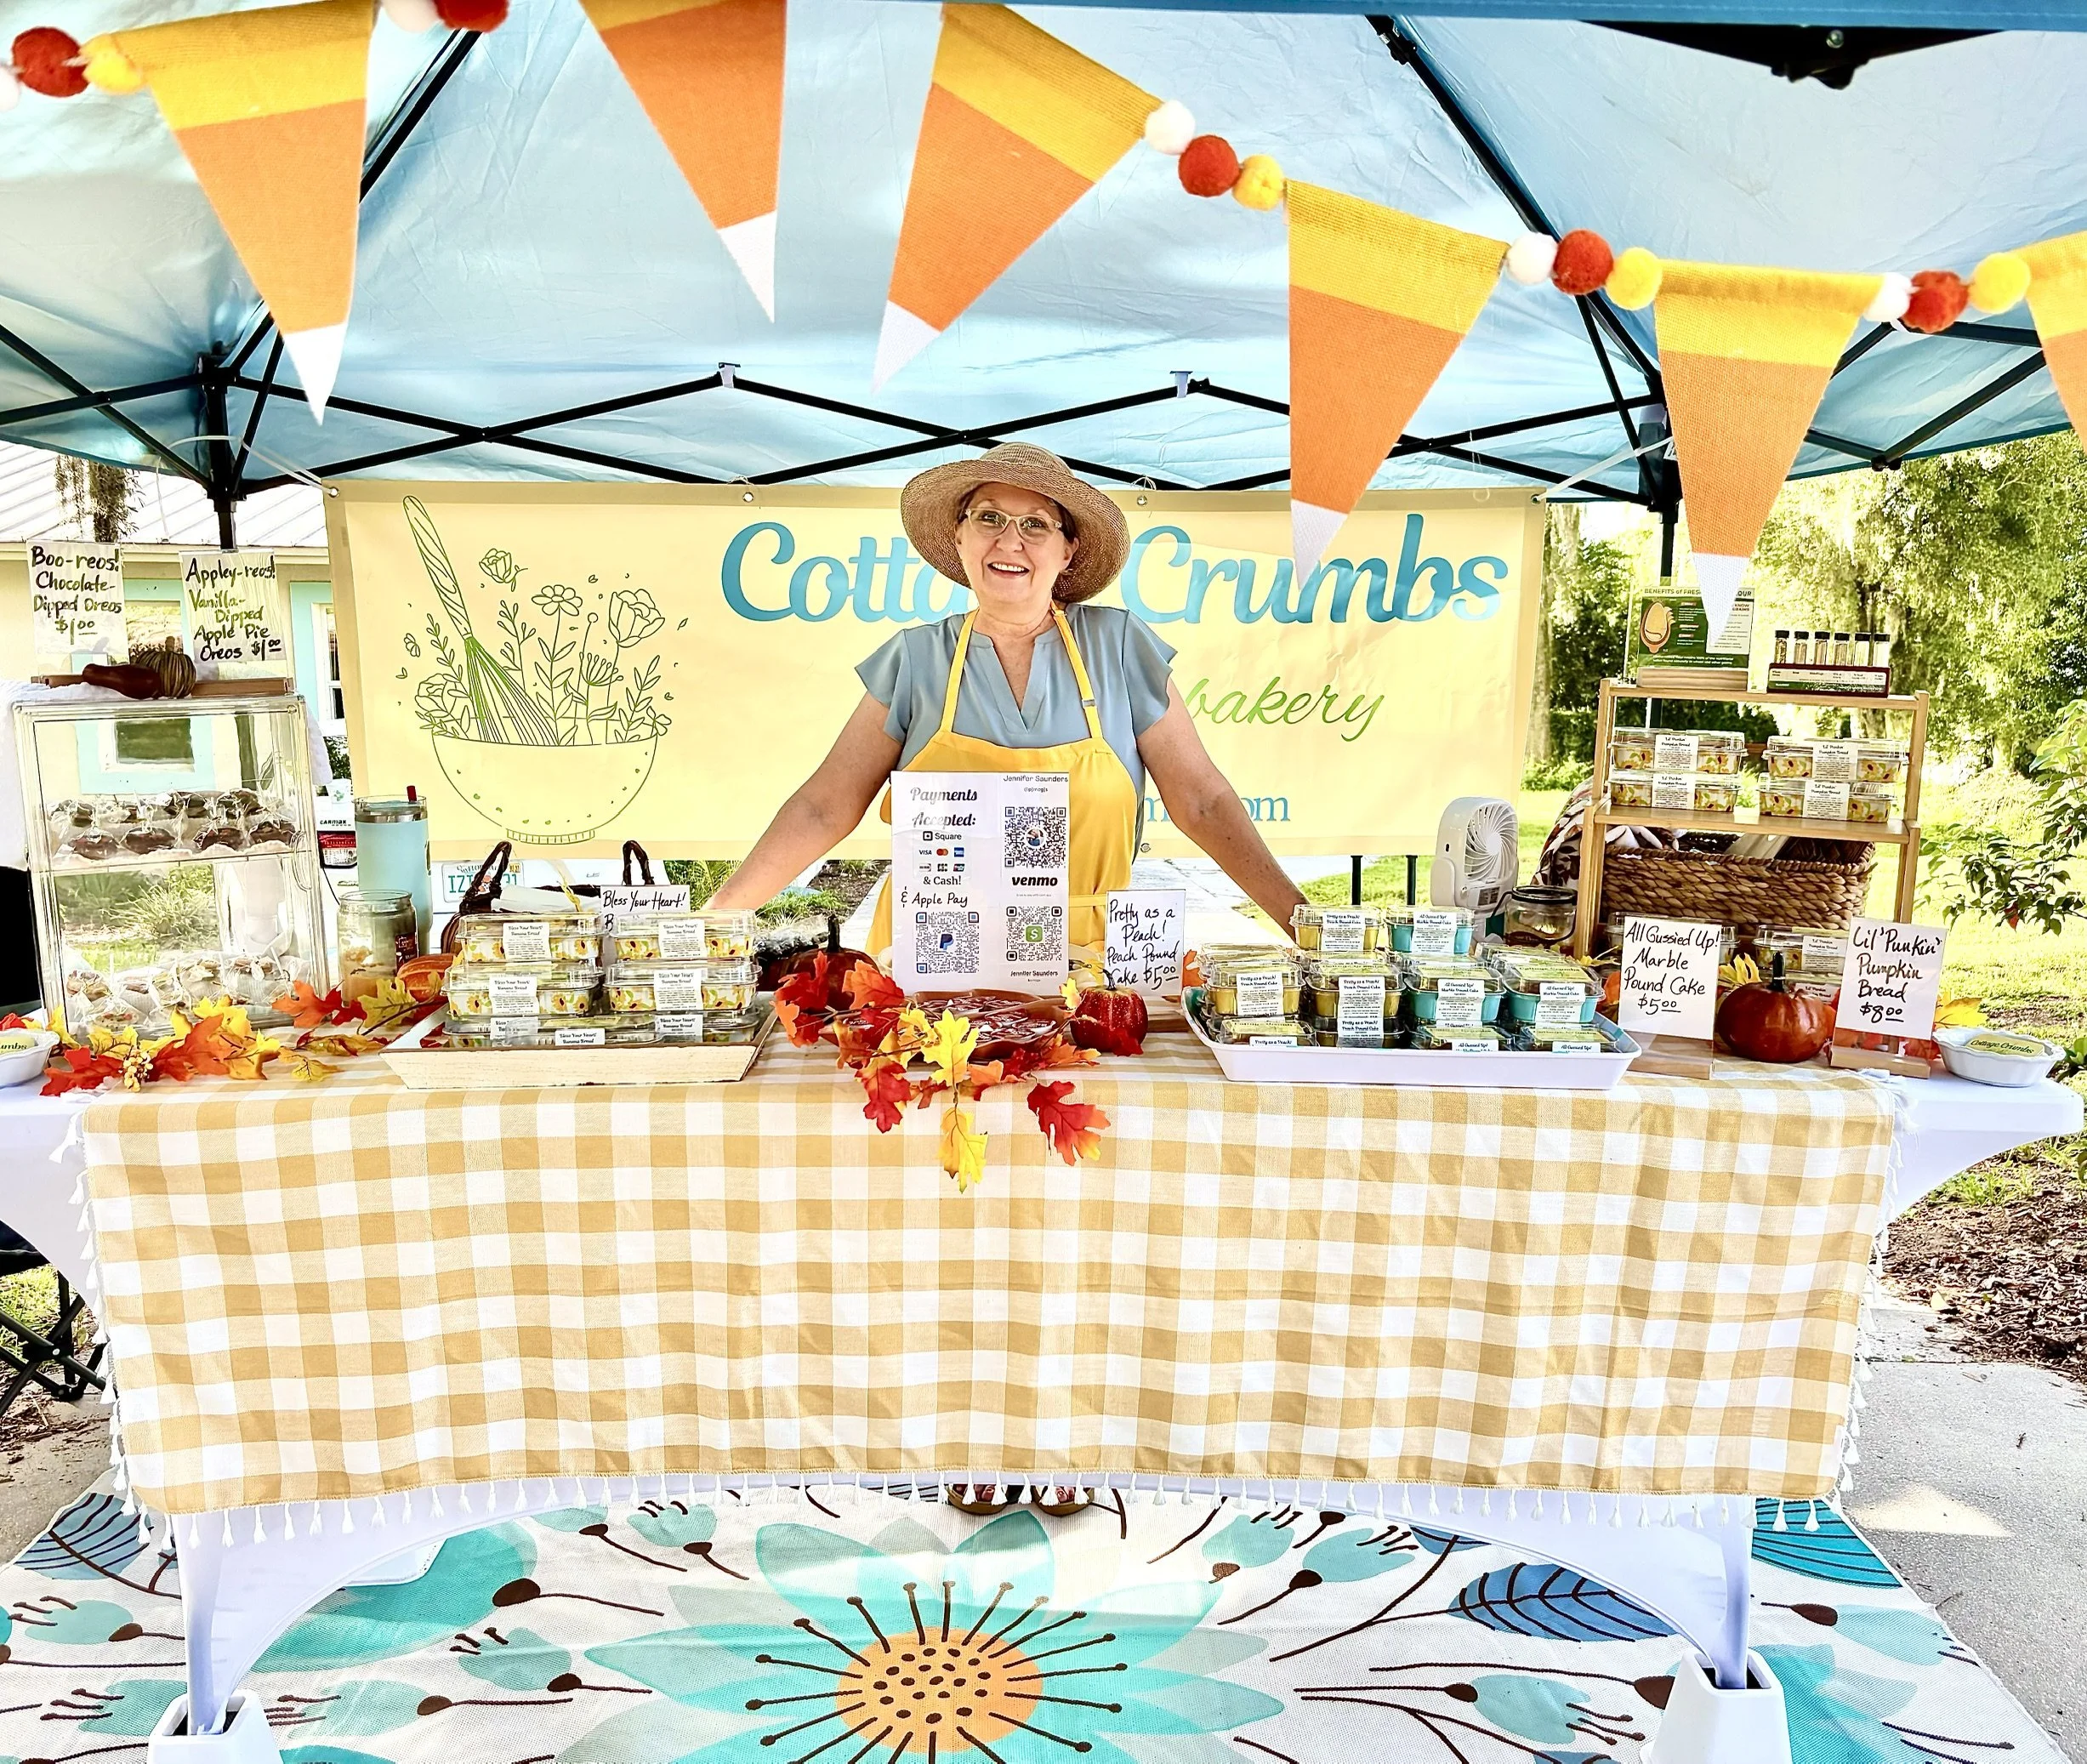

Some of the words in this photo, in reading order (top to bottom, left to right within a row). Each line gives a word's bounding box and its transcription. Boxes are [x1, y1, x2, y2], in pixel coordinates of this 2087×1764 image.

[31, 545, 119, 572] Boo-reos!
[721, 521, 970, 622] Cotta
[1121, 513, 1508, 623] Crumbs
[36, 571, 116, 592] Chocolate-
[185, 555, 276, 589] Appley-reos!
[33, 594, 78, 618] Dipped
[84, 597, 122, 613] Oreos
[214, 606, 264, 629] Dipped
[194, 624, 236, 646] Apple
[244, 623, 270, 639] Pie
[200, 645, 242, 661] Oreos
[1186, 676, 1385, 742] bakery
[910, 787, 977, 805] Payments
[912, 811, 976, 829] Accepted:
[935, 832, 963, 841] Square
[923, 875, 931, 885] &
[933, 874, 962, 885] Cash!
[1011, 877, 1059, 886] venmo
[603, 890, 628, 908] Bless
[629, 890, 651, 912] Your
[651, 891, 687, 910] Heart!
[912, 891, 943, 908] Apple
[947, 891, 969, 908] Pay
[1110, 898, 1139, 929] Pretty
[1145, 908, 1159, 919] as
[1166, 908, 1175, 918] a
[1121, 919, 1167, 947] Peach!
[1625, 920, 1646, 943] All
[1646, 925, 1696, 946] Gussied
[1696, 930, 1720, 956] Up!
[1853, 926, 1884, 950] Lil'
[1885, 929, 1942, 956] Punkin'
[1107, 946, 1138, 967] Peach
[1141, 940, 1180, 970] Pound
[1633, 947, 1688, 970] Marble
[1857, 953, 1923, 984] Pumpkin
[1624, 966, 1667, 993] Pound
[1670, 976, 1705, 995] Cake
[1858, 979, 1908, 1003] Bread
[1970, 1039, 2000, 1049] Cottage
[2000, 1042, 2034, 1054] Crumbs
